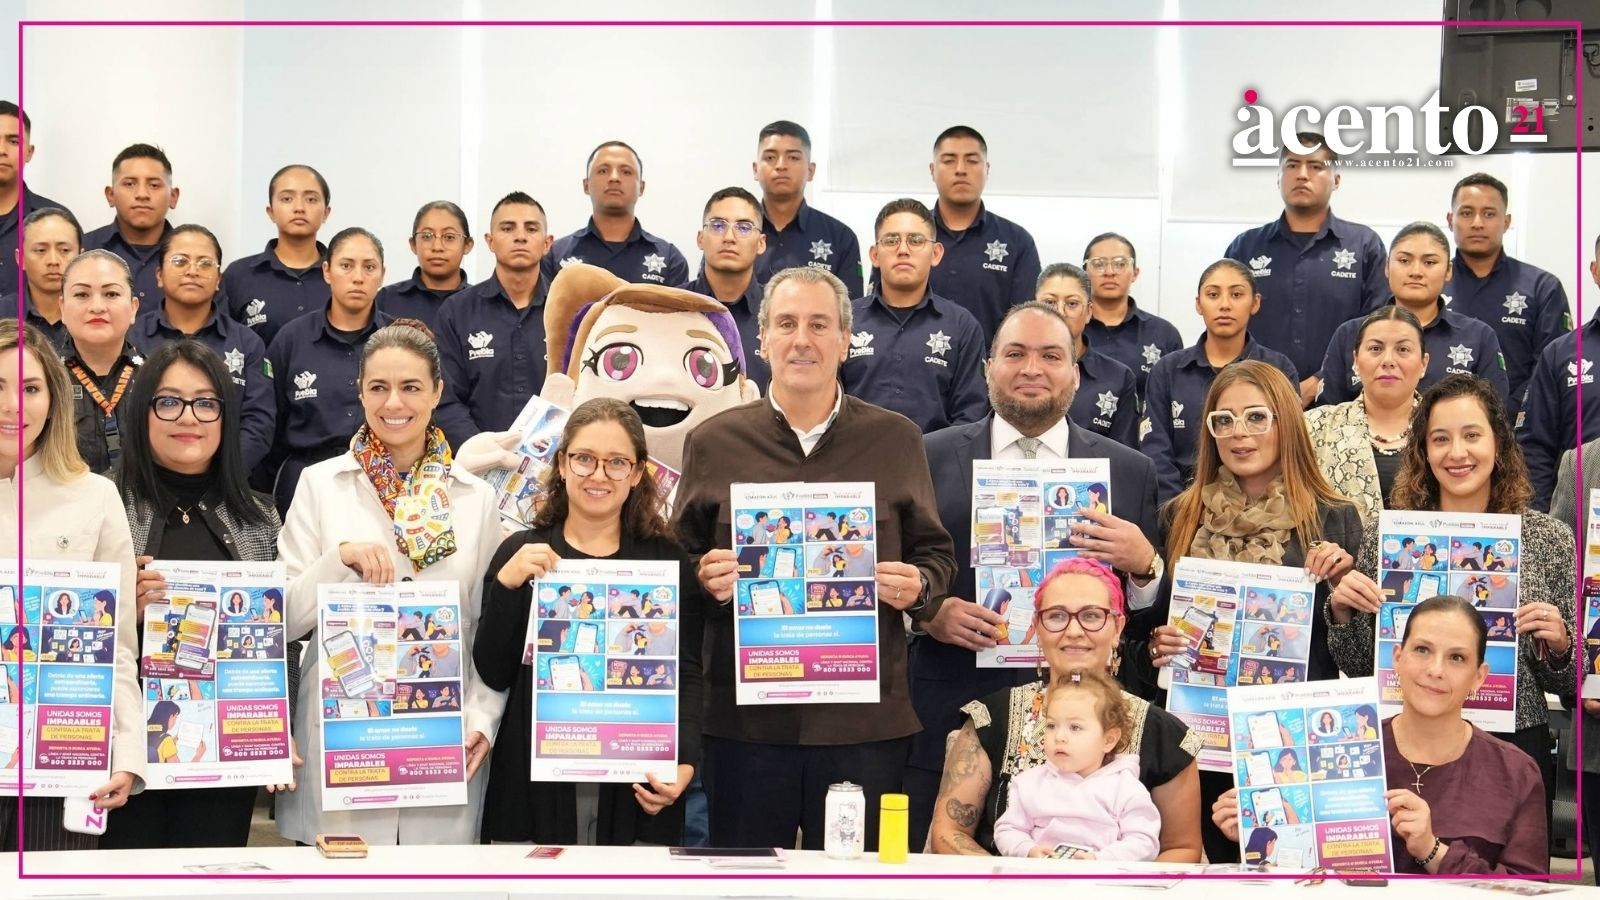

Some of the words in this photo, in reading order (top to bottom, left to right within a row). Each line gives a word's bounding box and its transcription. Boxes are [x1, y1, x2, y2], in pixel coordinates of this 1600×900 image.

[982, 263, 1008, 272] CADETE
[642, 273, 665, 283] CADETE
[1331, 270, 1357, 279] CADETE
[1501, 316, 1527, 325] CADETE
[924, 356, 949, 367] CADETE
[226, 711, 279, 719] IMPARABLES
[47, 718, 102, 726] IMPARABLES
[545, 733, 598, 741] IMPARABLES
[334, 760, 386, 769] IMPARABLES
[1324, 825, 1352, 834] UNIDAS
[1353, 824, 1380, 832] SOMOS
[1325, 832, 1380, 842] IMPARABLES
